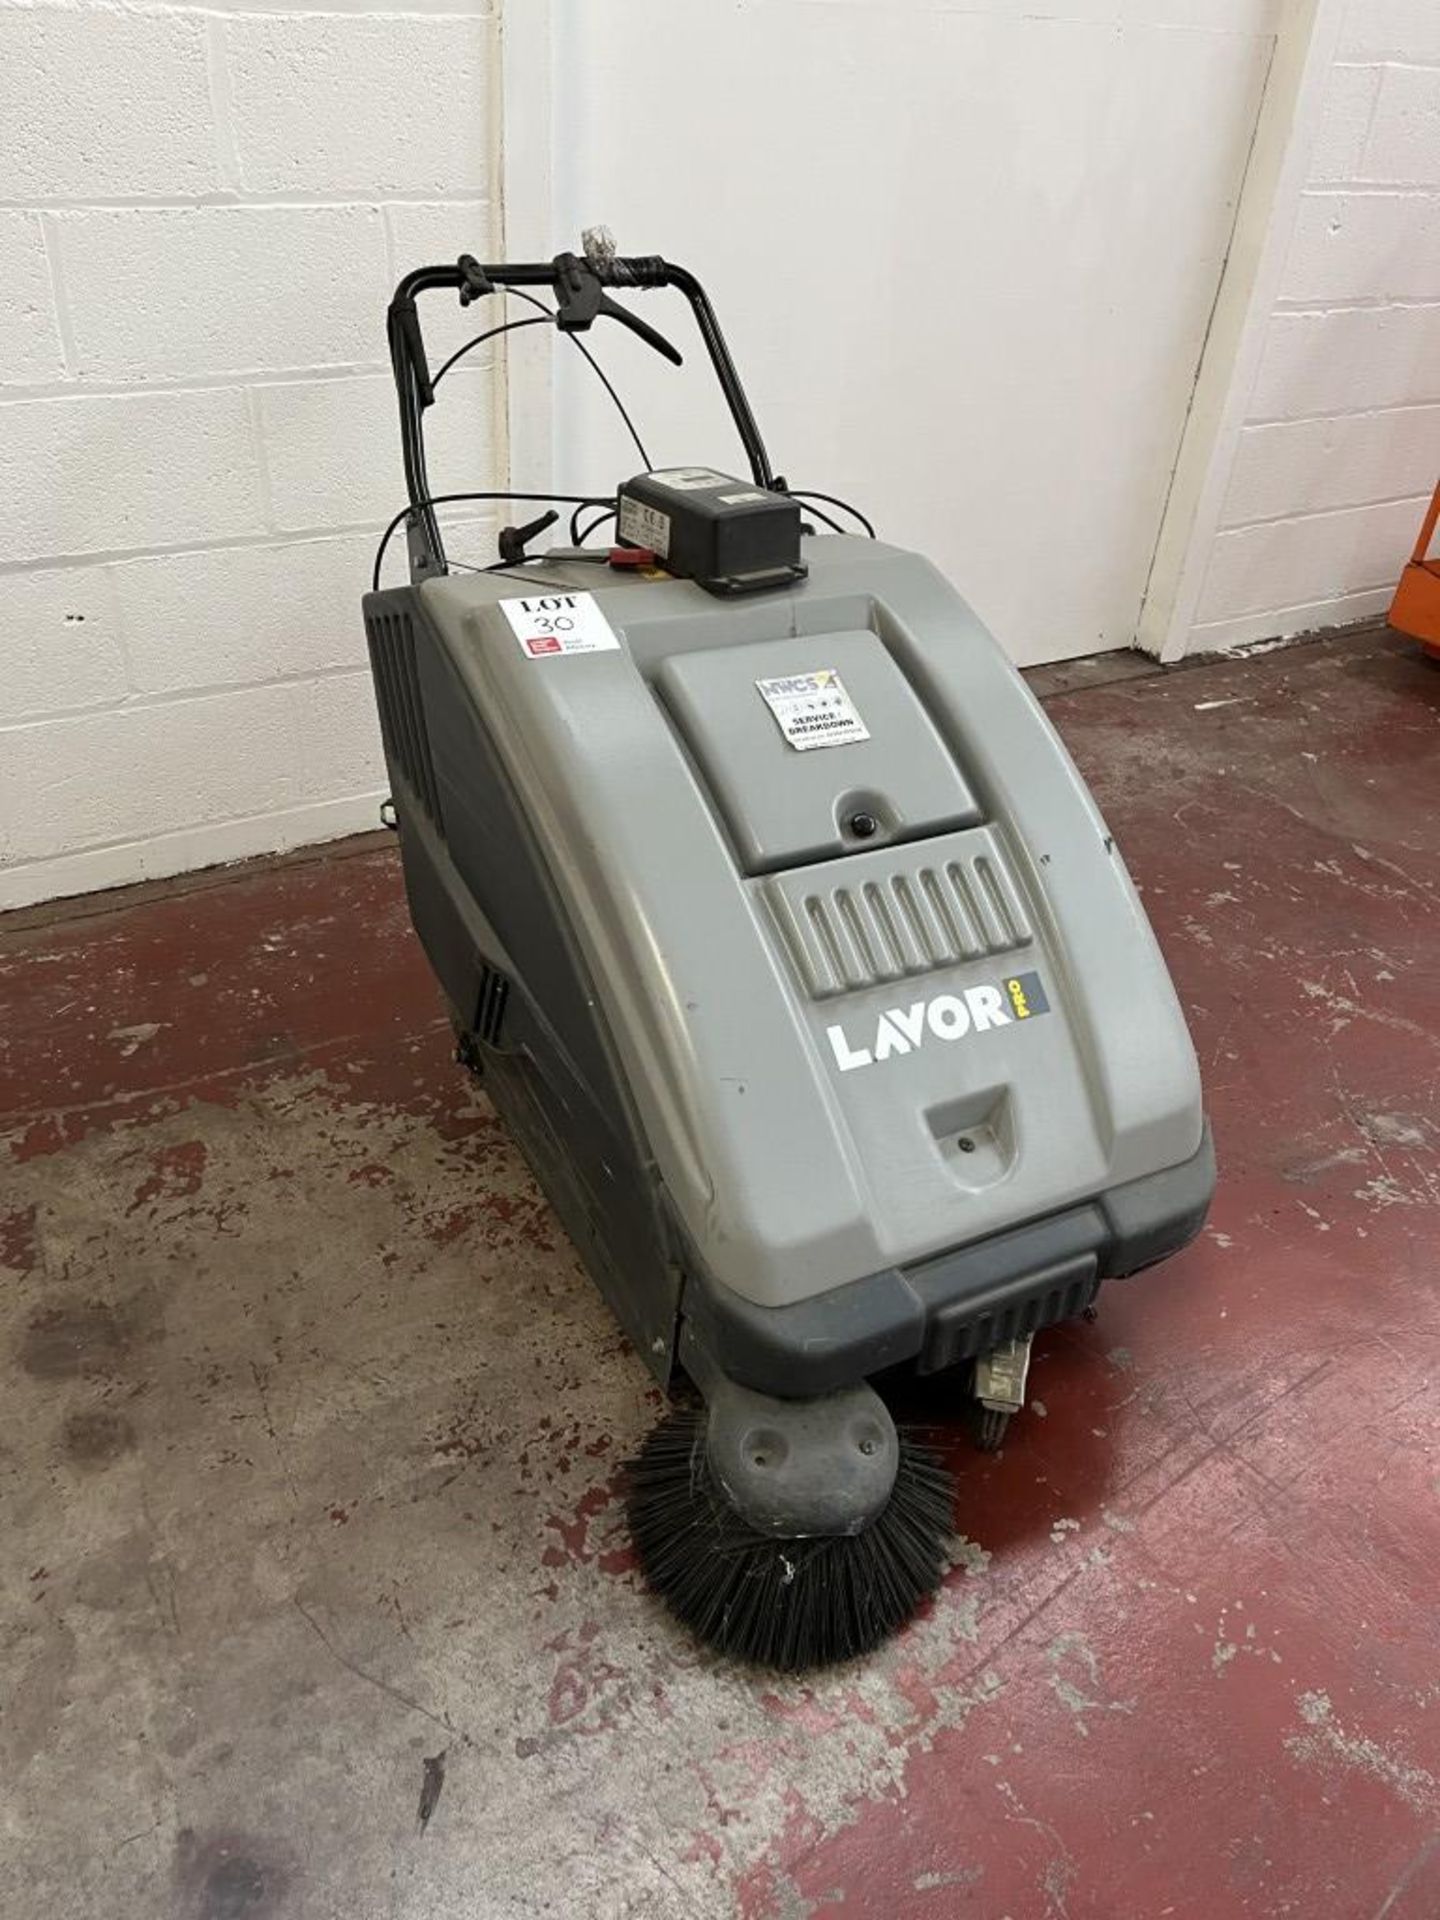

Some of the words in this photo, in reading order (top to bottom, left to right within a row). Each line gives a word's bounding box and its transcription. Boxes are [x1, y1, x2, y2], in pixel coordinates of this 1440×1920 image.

[520, 595, 577, 613] LOT
[534, 616, 574, 634] 30
[788, 718, 854, 736] BREAKDOWN
[792, 711, 836, 725] SERVICE
[826, 985, 1012, 1071] LAVOR
[1008, 980, 1030, 1018] PRO
